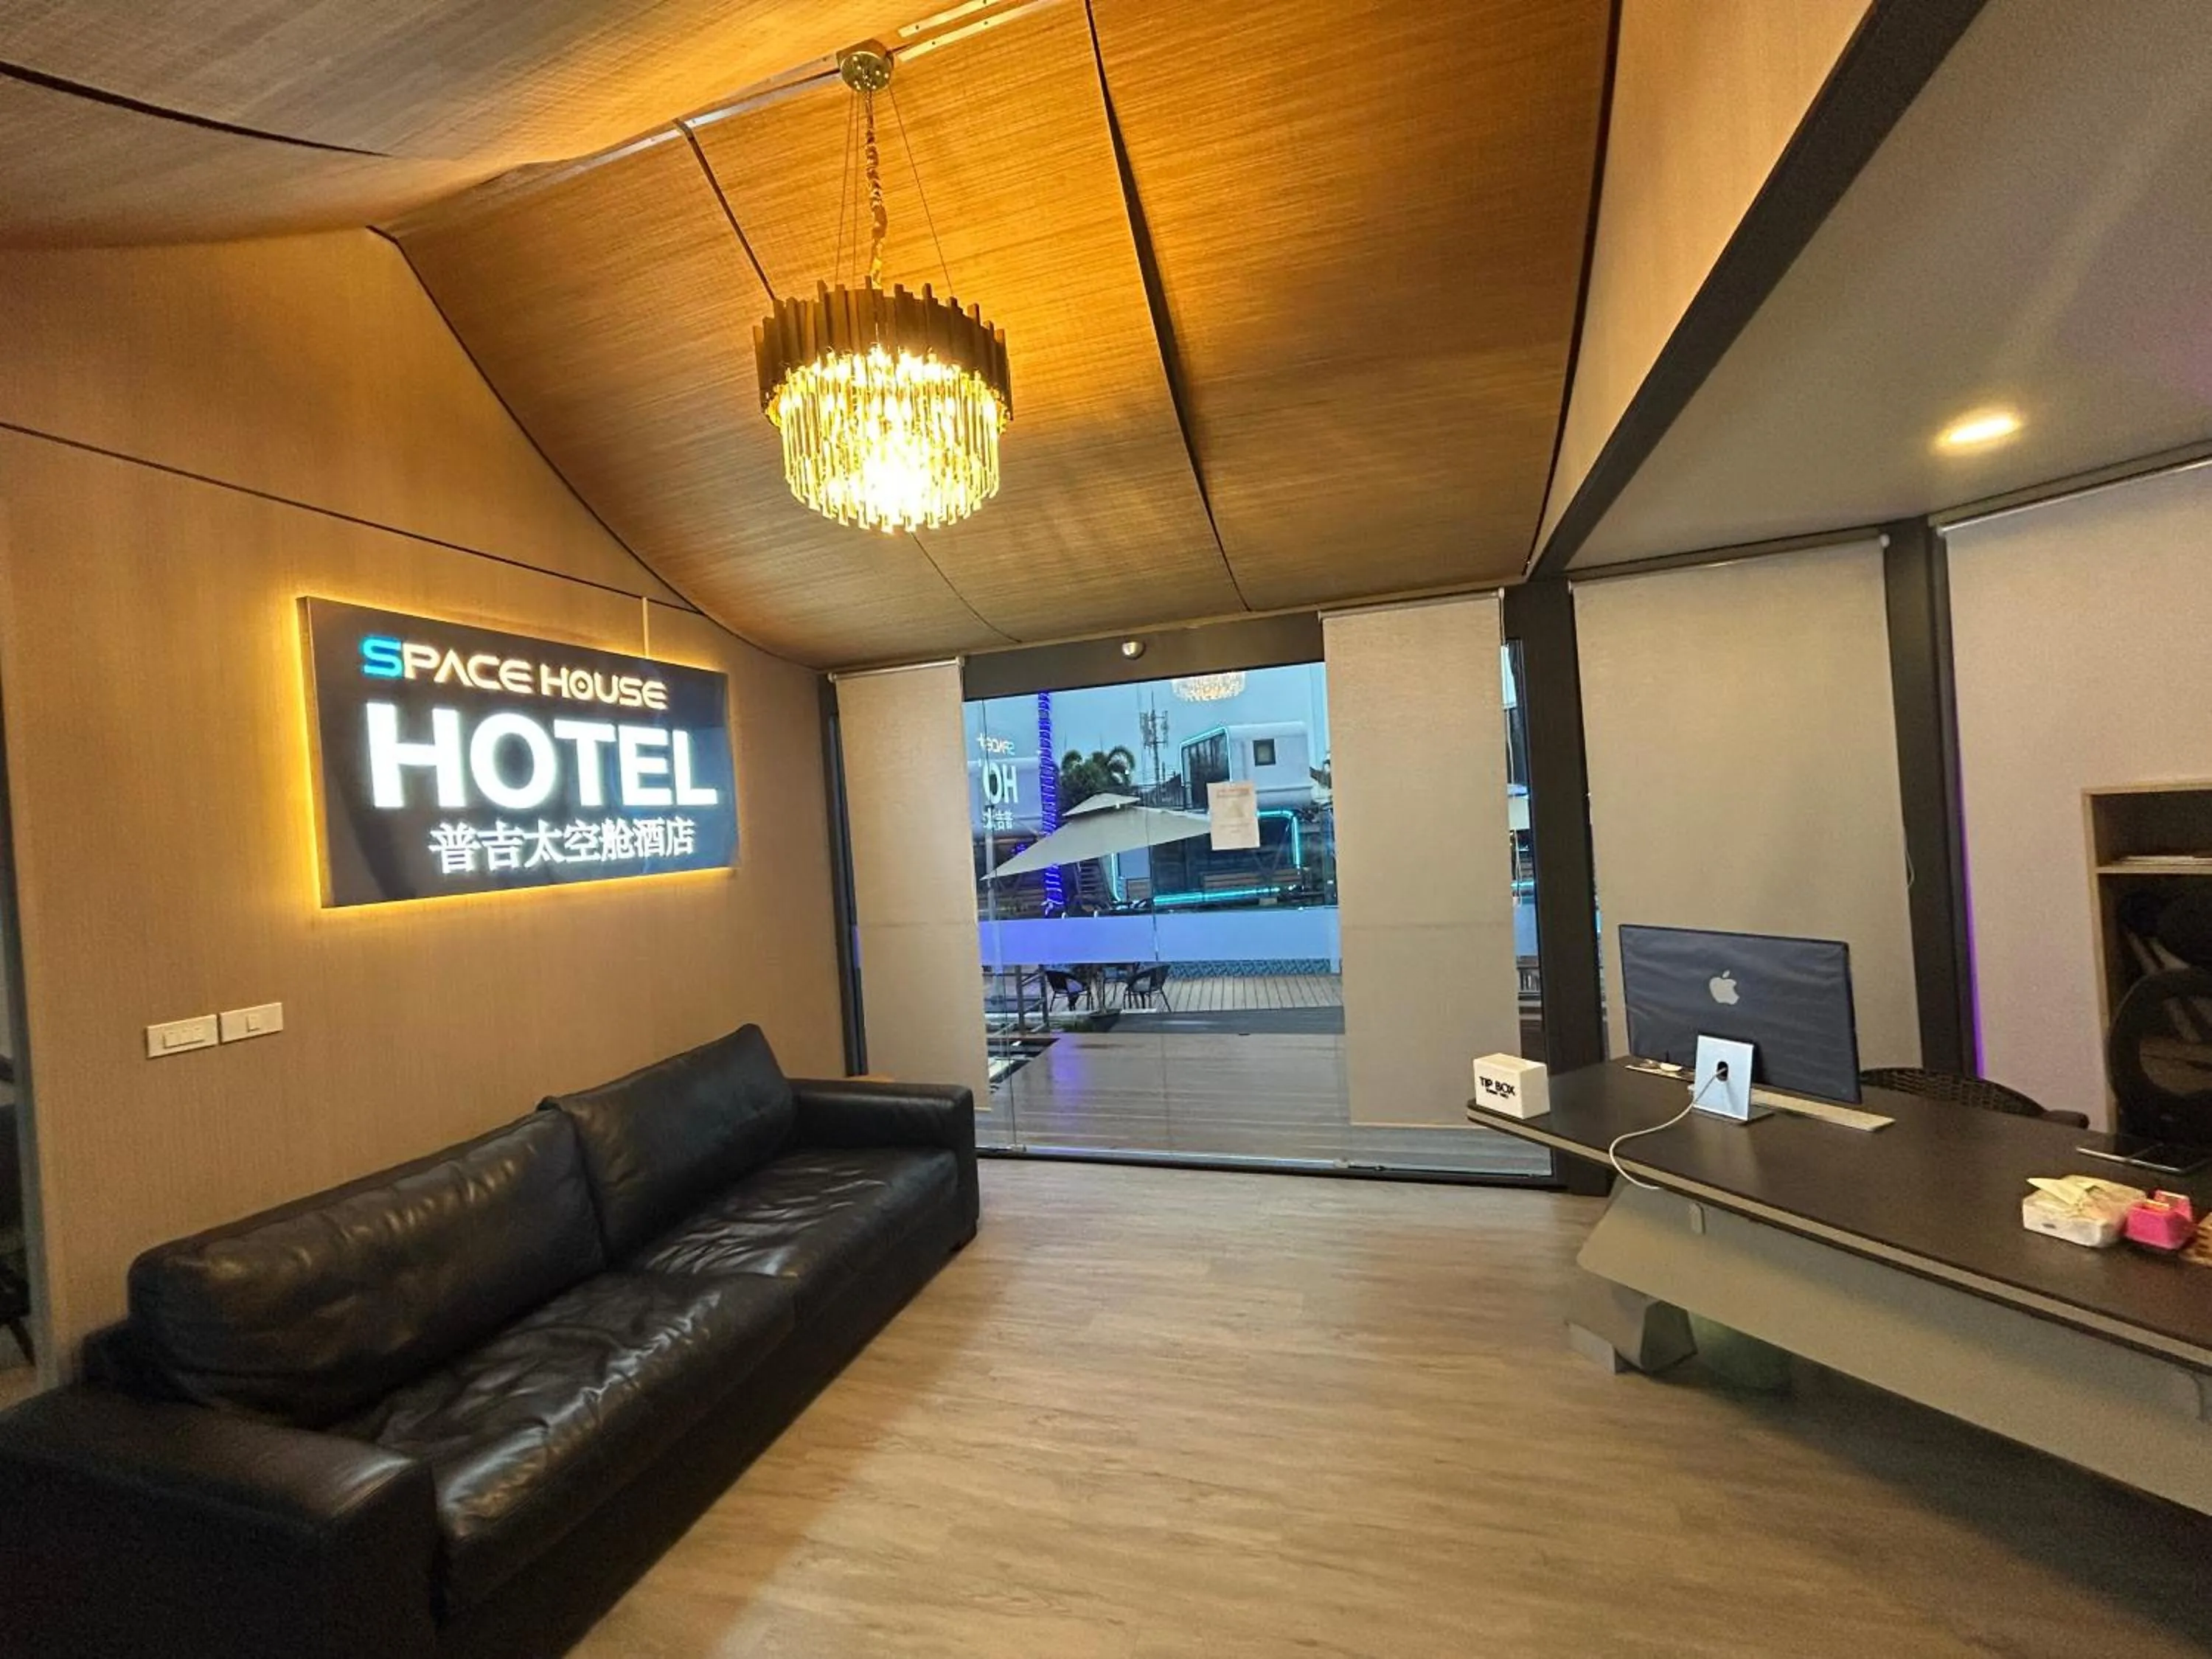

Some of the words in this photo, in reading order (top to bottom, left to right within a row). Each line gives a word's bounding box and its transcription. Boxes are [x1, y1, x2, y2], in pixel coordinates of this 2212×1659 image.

[362, 636, 535, 695] SPACE
[540, 664, 668, 709] HOUSE
[366, 701, 718, 809] HOTEL
[428, 816, 696, 874] 普吉太空舱酒店
[1479, 1076, 1493, 1088] TIP
[1495, 1080, 1515, 1096] BOX
